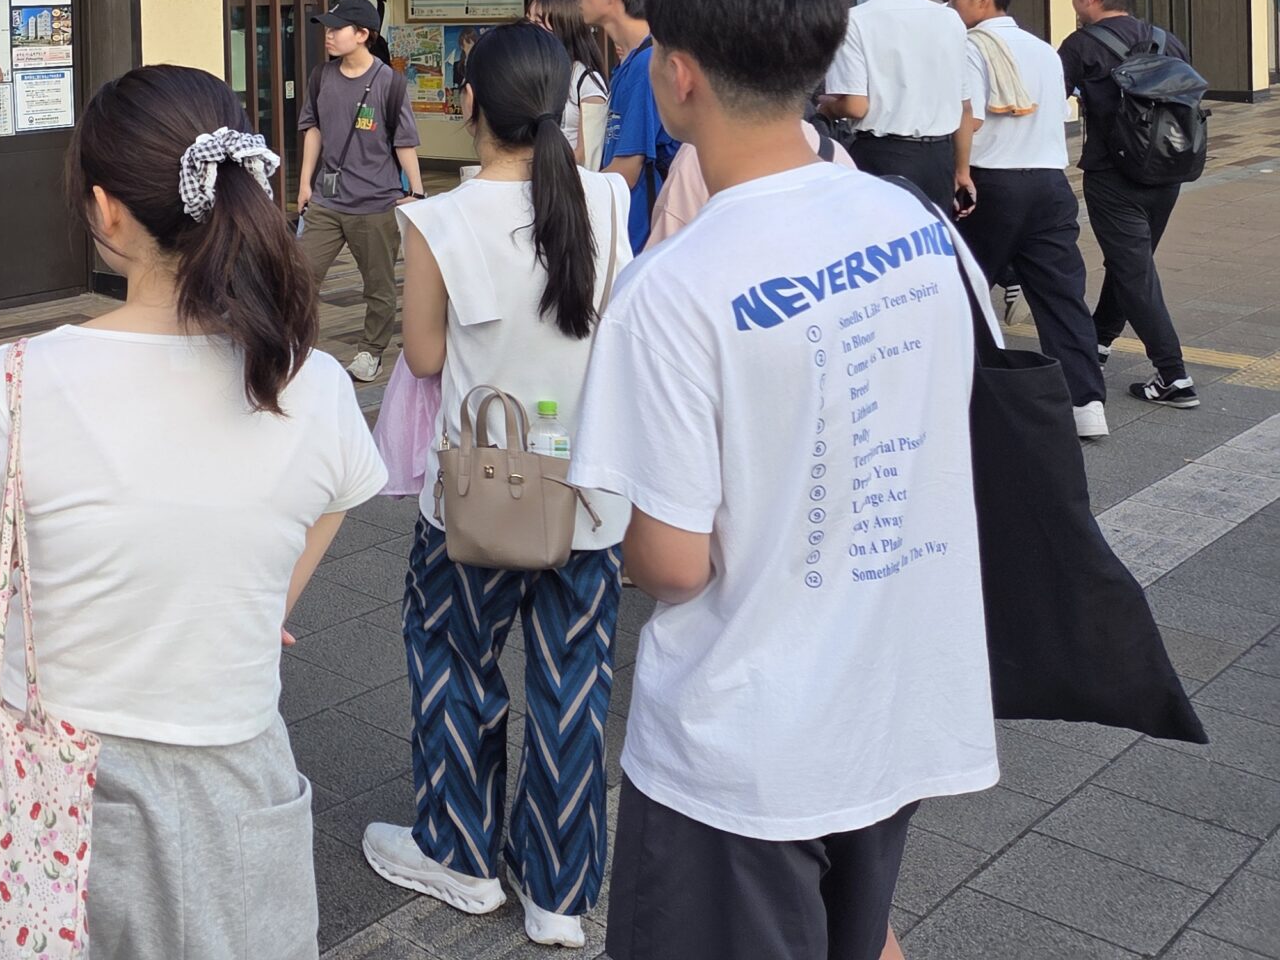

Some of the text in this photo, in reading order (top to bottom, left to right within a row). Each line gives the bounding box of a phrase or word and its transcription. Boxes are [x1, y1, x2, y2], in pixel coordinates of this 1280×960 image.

[882, 294, 908, 309] Teen
[908, 282, 939, 303] Spirit
[878, 346, 900, 359] You
[902, 339, 923, 353] Are
[873, 466, 898, 479] You
[888, 489, 907, 502] Act
[873, 515, 904, 529] Away
[848, 543, 867, 557] On
[869, 541, 879, 555] A
[925, 541, 949, 556] Way
